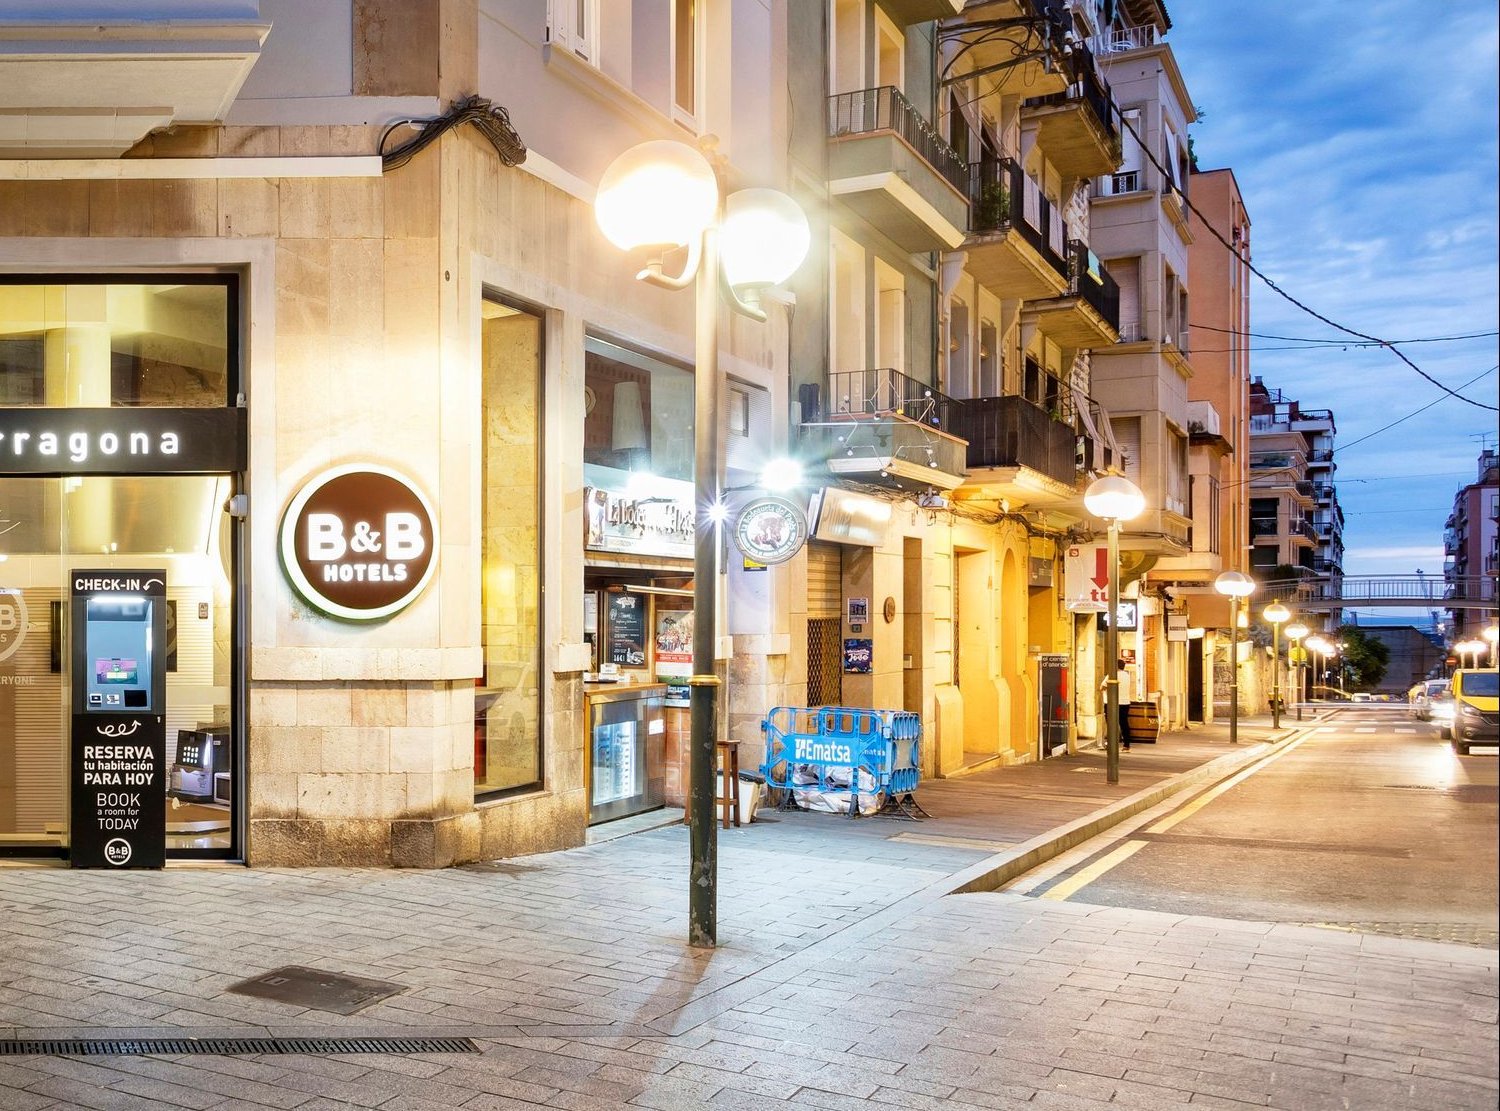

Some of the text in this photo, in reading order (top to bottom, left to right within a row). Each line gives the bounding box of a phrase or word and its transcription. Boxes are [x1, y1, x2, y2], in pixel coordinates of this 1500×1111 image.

[307, 511, 426, 561] B&B
[323, 563, 408, 582] HOTELS
[74, 578, 141, 591] CHECK-IN
[84, 746, 155, 760] RESERVA
[805, 738, 851, 763] Ematsa
[84, 760, 154, 771] tu habitación
[84, 773, 155, 785] PARA HOY
[97, 793, 141, 807] BOOK
[127, 807, 140, 816] for
[98, 818, 140, 830] TODAY
[108, 846, 129, 856] B&B
